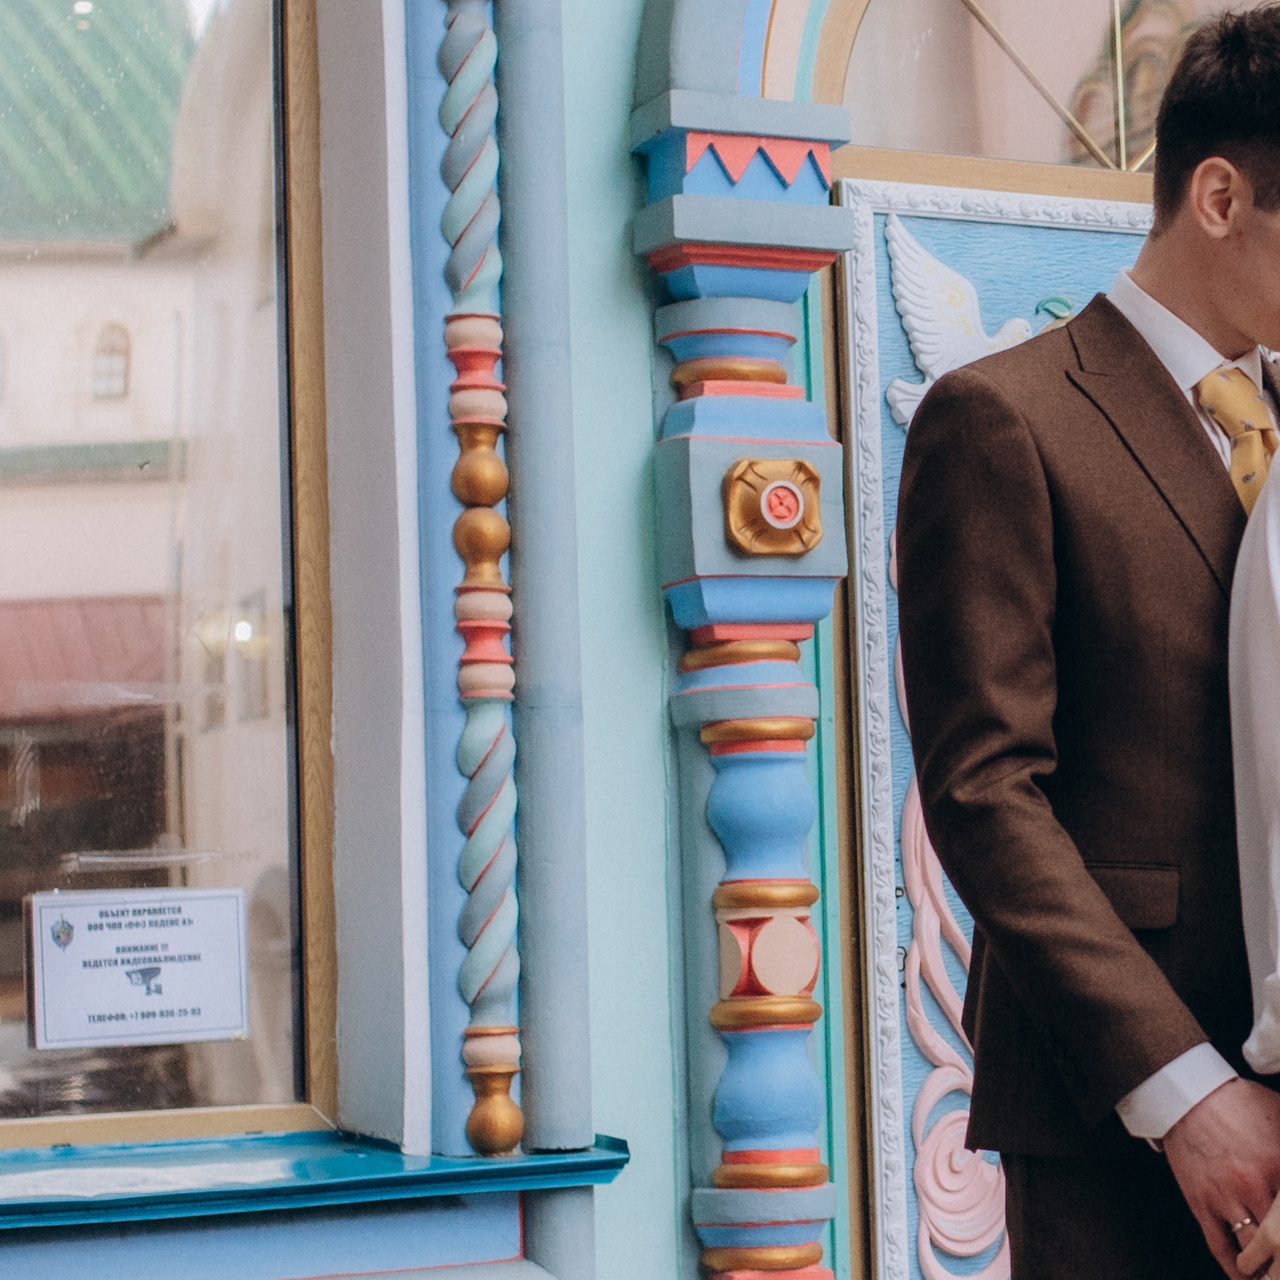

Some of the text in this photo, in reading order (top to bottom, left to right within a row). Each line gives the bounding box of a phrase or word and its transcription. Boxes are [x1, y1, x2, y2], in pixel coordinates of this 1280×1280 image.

[99, 906, 182, 918] ОБЪЕКТ ОХРАНЯЕТСЯ
[115, 944, 158, 953] ВНИМАНИЕ
[82, 953, 201, 968] ВЕДЕТСЯ ВИДЕОНАБЛЮДЕНИЕ
